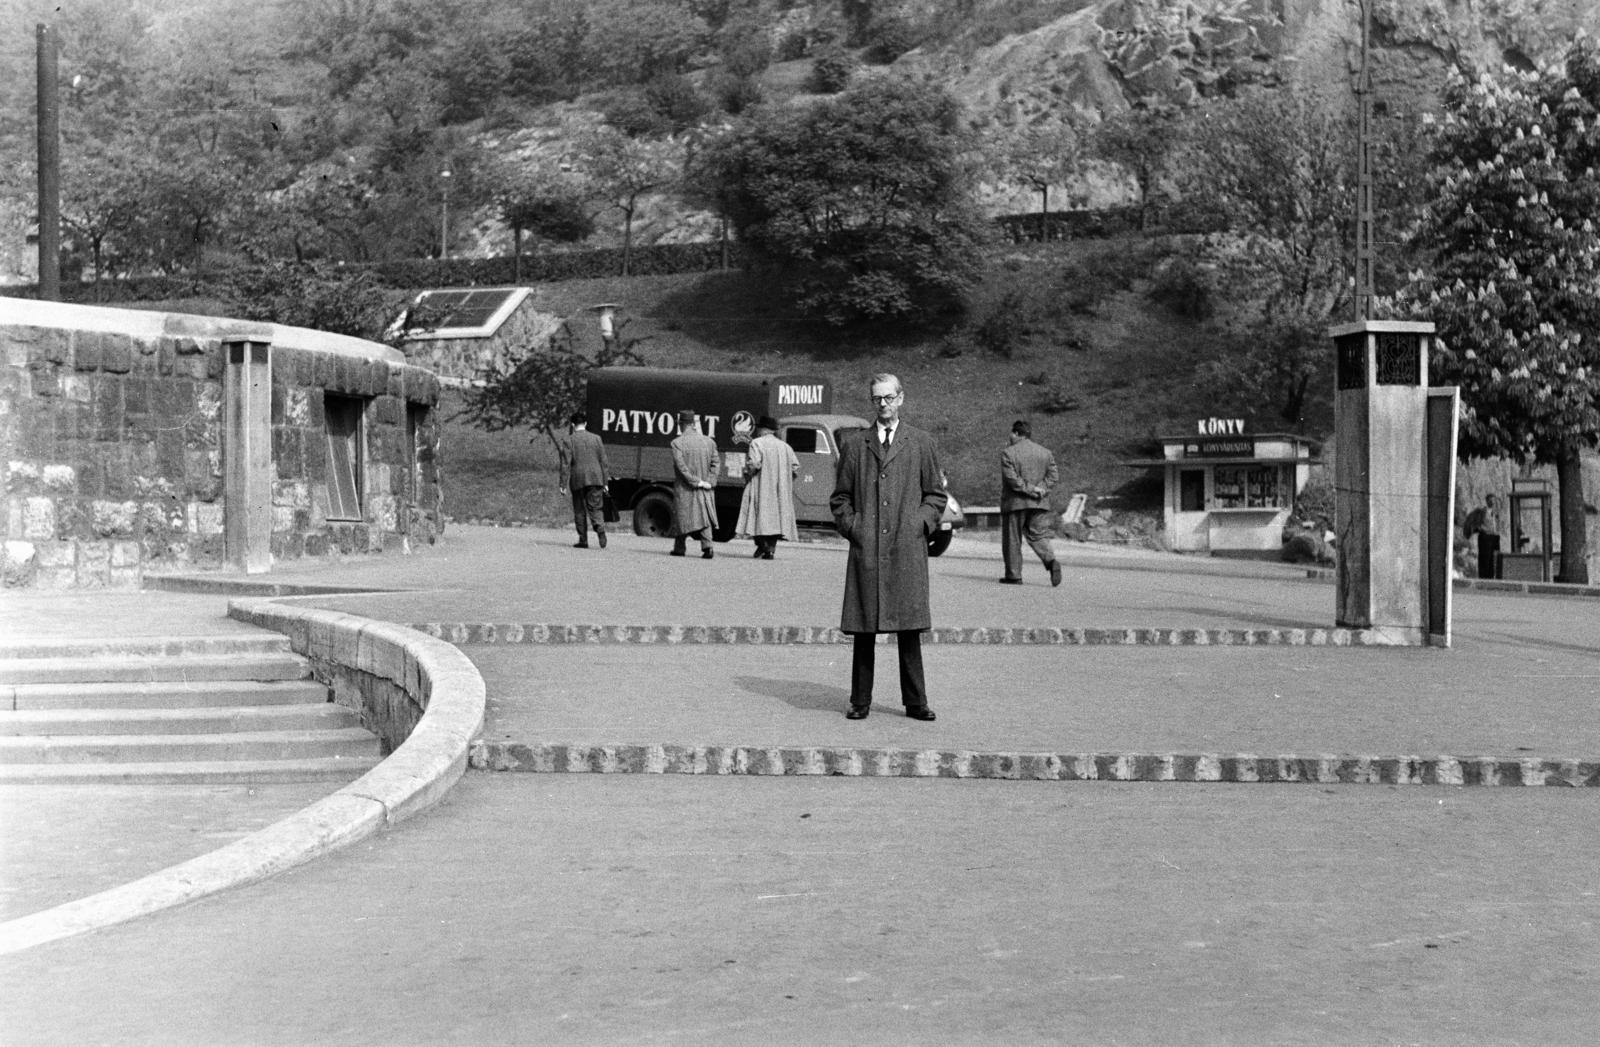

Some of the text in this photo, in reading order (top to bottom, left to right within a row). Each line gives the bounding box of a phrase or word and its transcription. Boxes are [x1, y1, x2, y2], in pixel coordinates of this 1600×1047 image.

[778, 384, 824, 404] PATYOLAT
[602, 408, 720, 438] PATYOAT
[1198, 416, 1244, 435] KÖNYV
